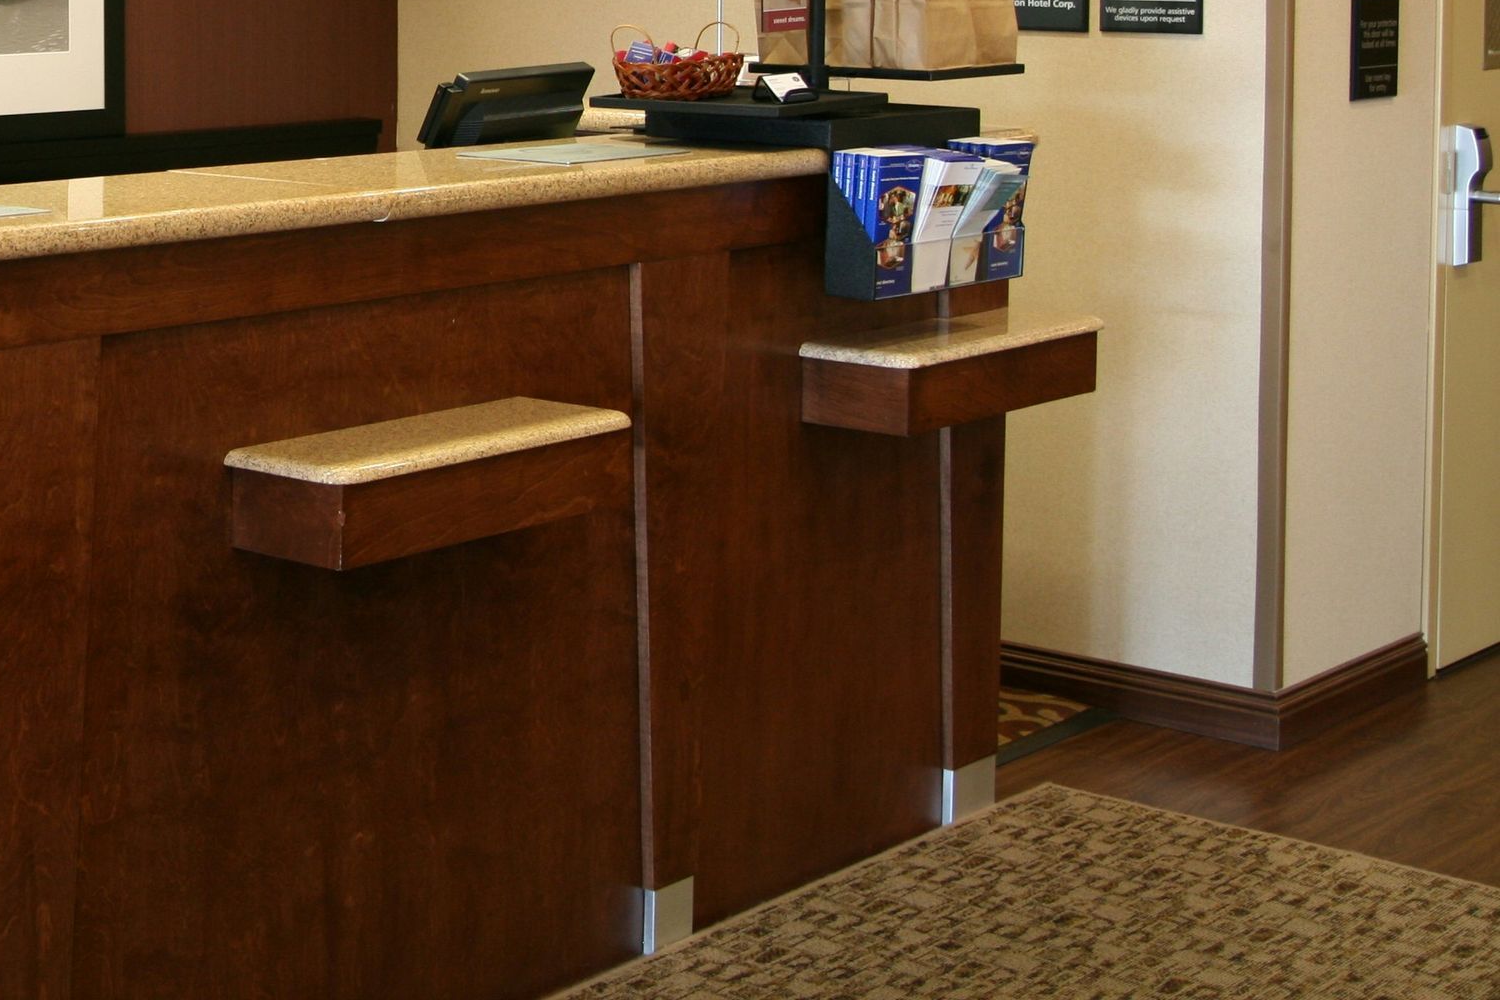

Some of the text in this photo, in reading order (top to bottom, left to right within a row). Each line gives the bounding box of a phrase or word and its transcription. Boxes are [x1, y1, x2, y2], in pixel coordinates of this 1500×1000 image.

[1027, 0, 1051, 7] Hotel
[1053, 0, 1076, 10] Corp.
[1118, 6, 1139, 15] gladly
[1140, 7, 1166, 15] provide
[1159, 16, 1186, 24] request
